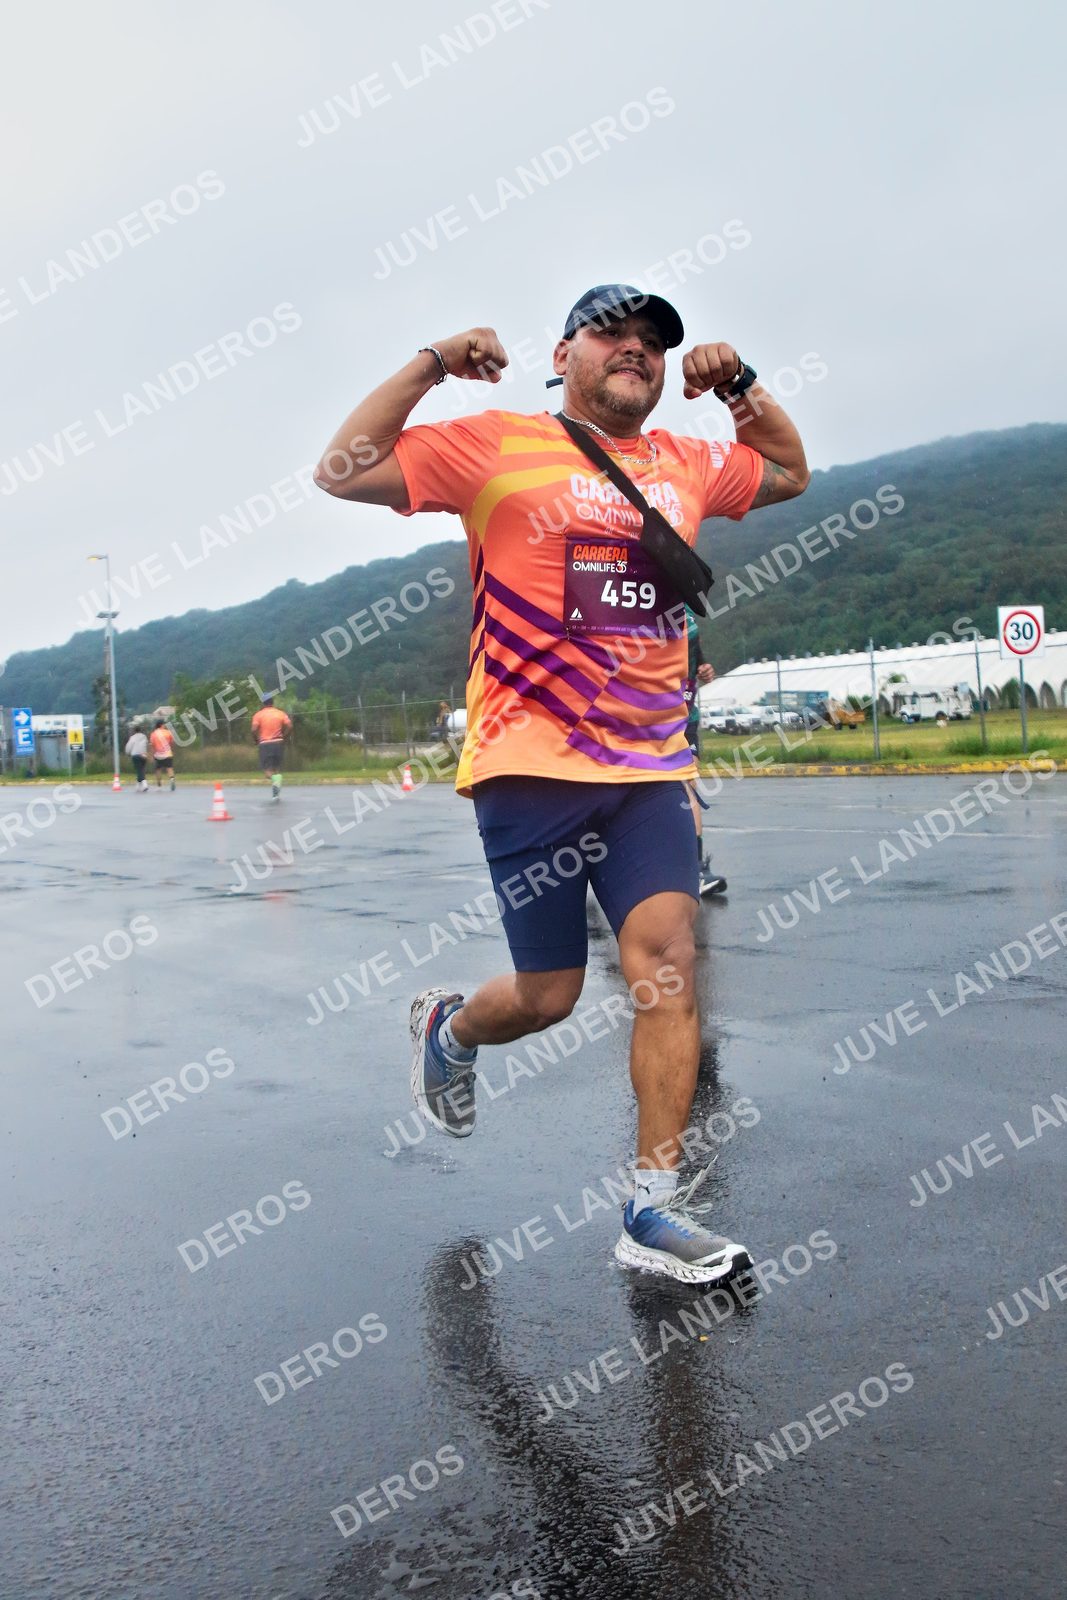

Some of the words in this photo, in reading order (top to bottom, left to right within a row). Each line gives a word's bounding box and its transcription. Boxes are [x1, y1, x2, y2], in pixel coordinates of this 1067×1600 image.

[573, 544, 628, 562] CARRERA
[601, 579, 657, 610] 459
[1010, 622, 1034, 640] 30
[18, 728, 31, 745] E
